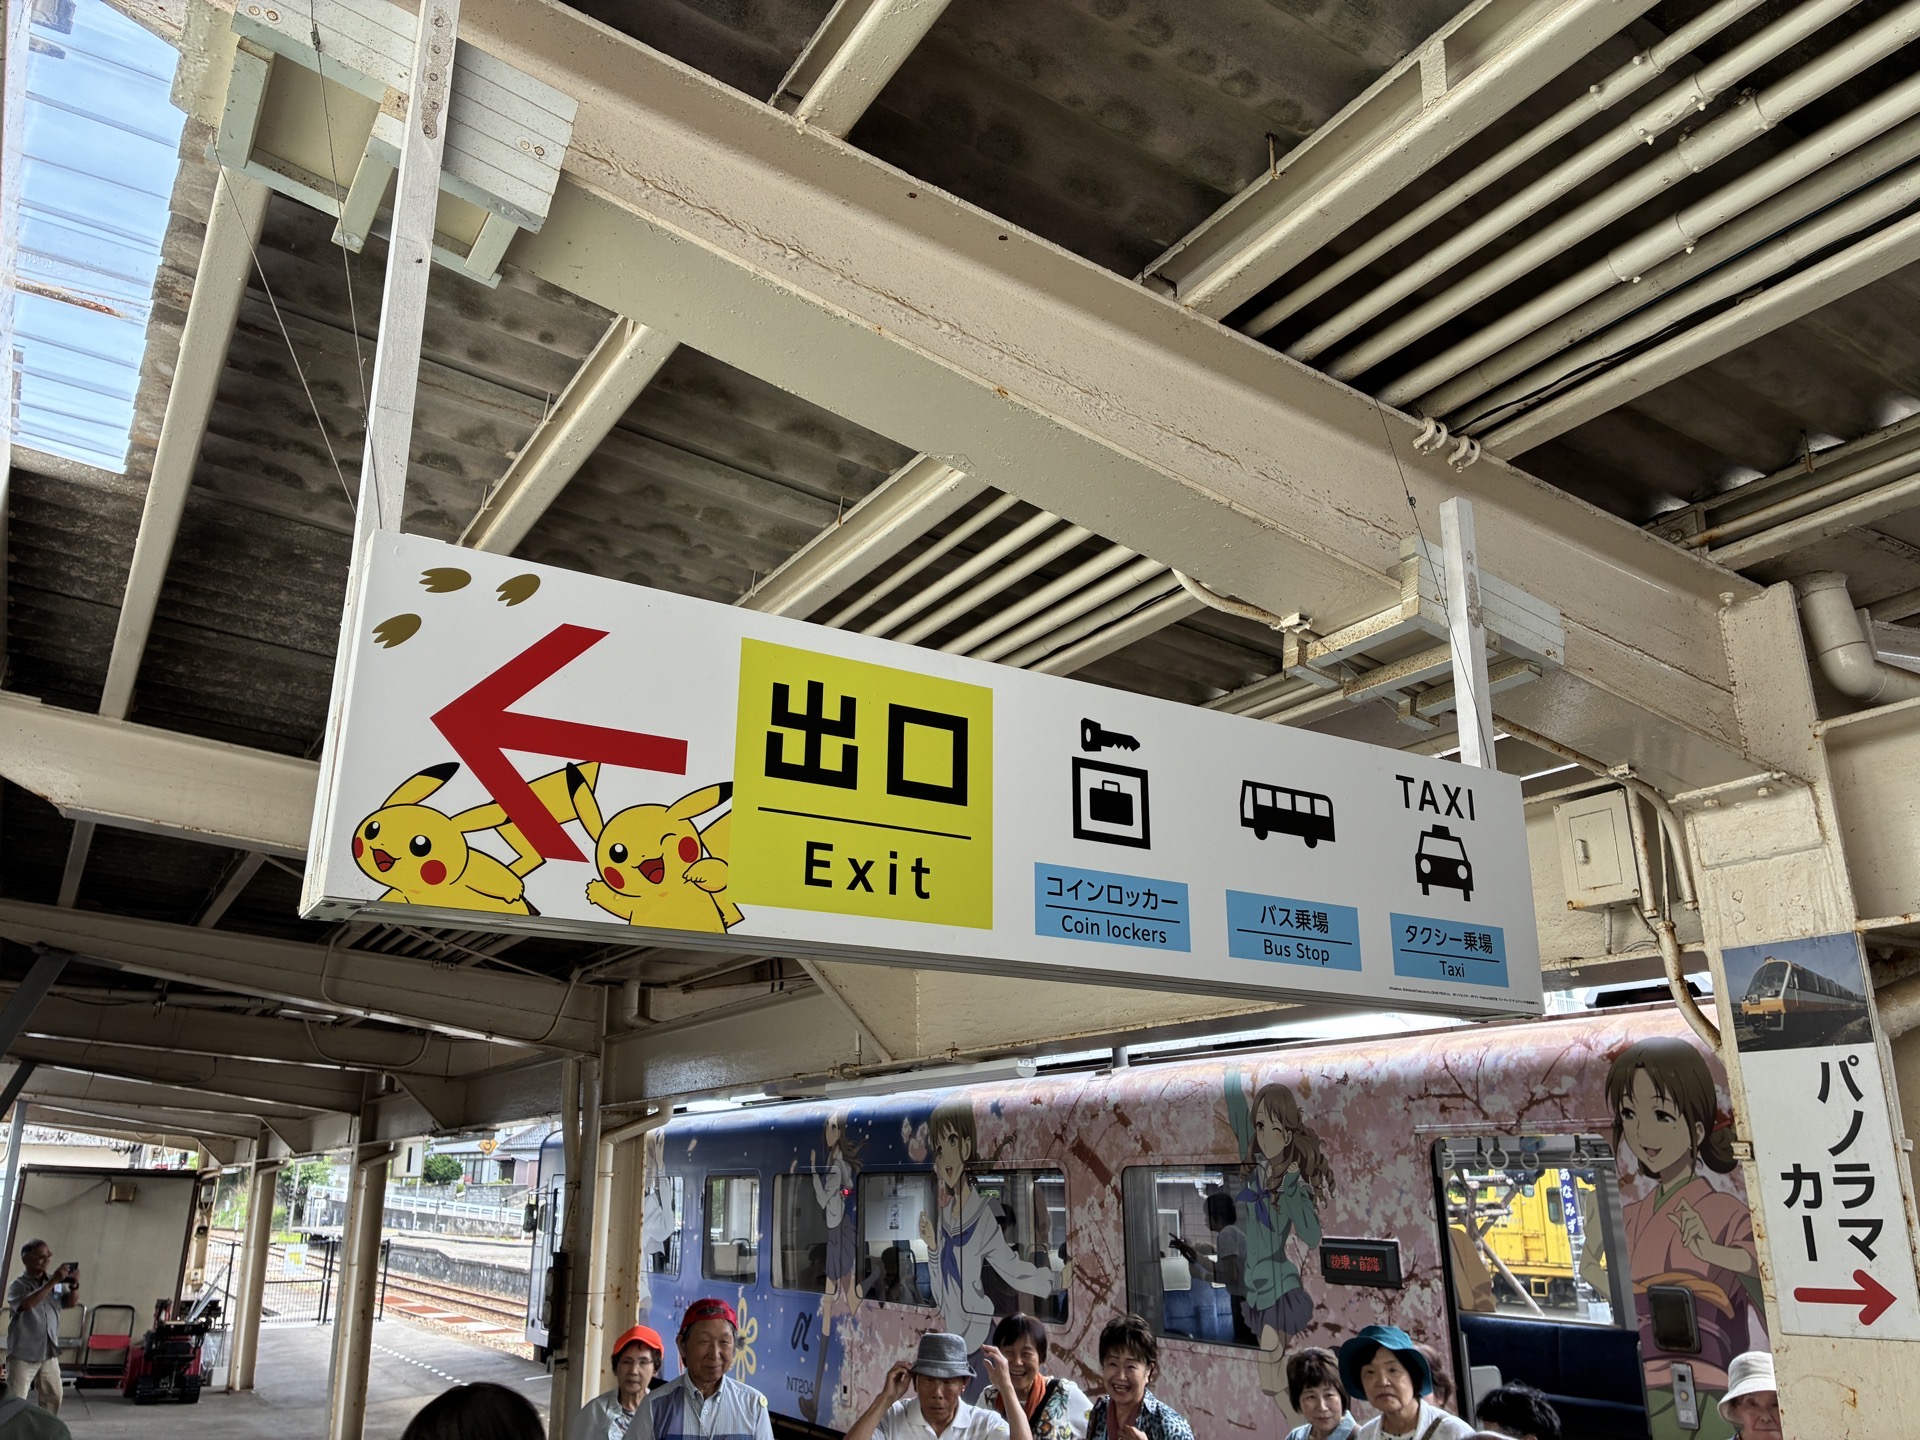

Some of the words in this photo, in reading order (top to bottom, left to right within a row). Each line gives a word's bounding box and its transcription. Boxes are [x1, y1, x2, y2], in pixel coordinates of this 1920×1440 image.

[765, 680, 968, 806] 出口
[1395, 774, 1475, 821] TAXI
[804, 841, 930, 899] Exit
[1046, 876, 1178, 910] コインロッカー
[1061, 915, 1100, 935] Coin
[1107, 919, 1167, 943] lockers
[1261, 905, 1328, 933] バス乗場
[1263, 939, 1291, 957] Bus
[1296, 943, 1330, 965] Stop
[1405, 925, 1493, 954] タクシー乗場
[1439, 961, 1465, 977] Taxi
[1817, 1054, 1884, 1262] パノラマ
[1780, 1163, 1823, 1262] カー
[786, 1375, 814, 1396] NT204
